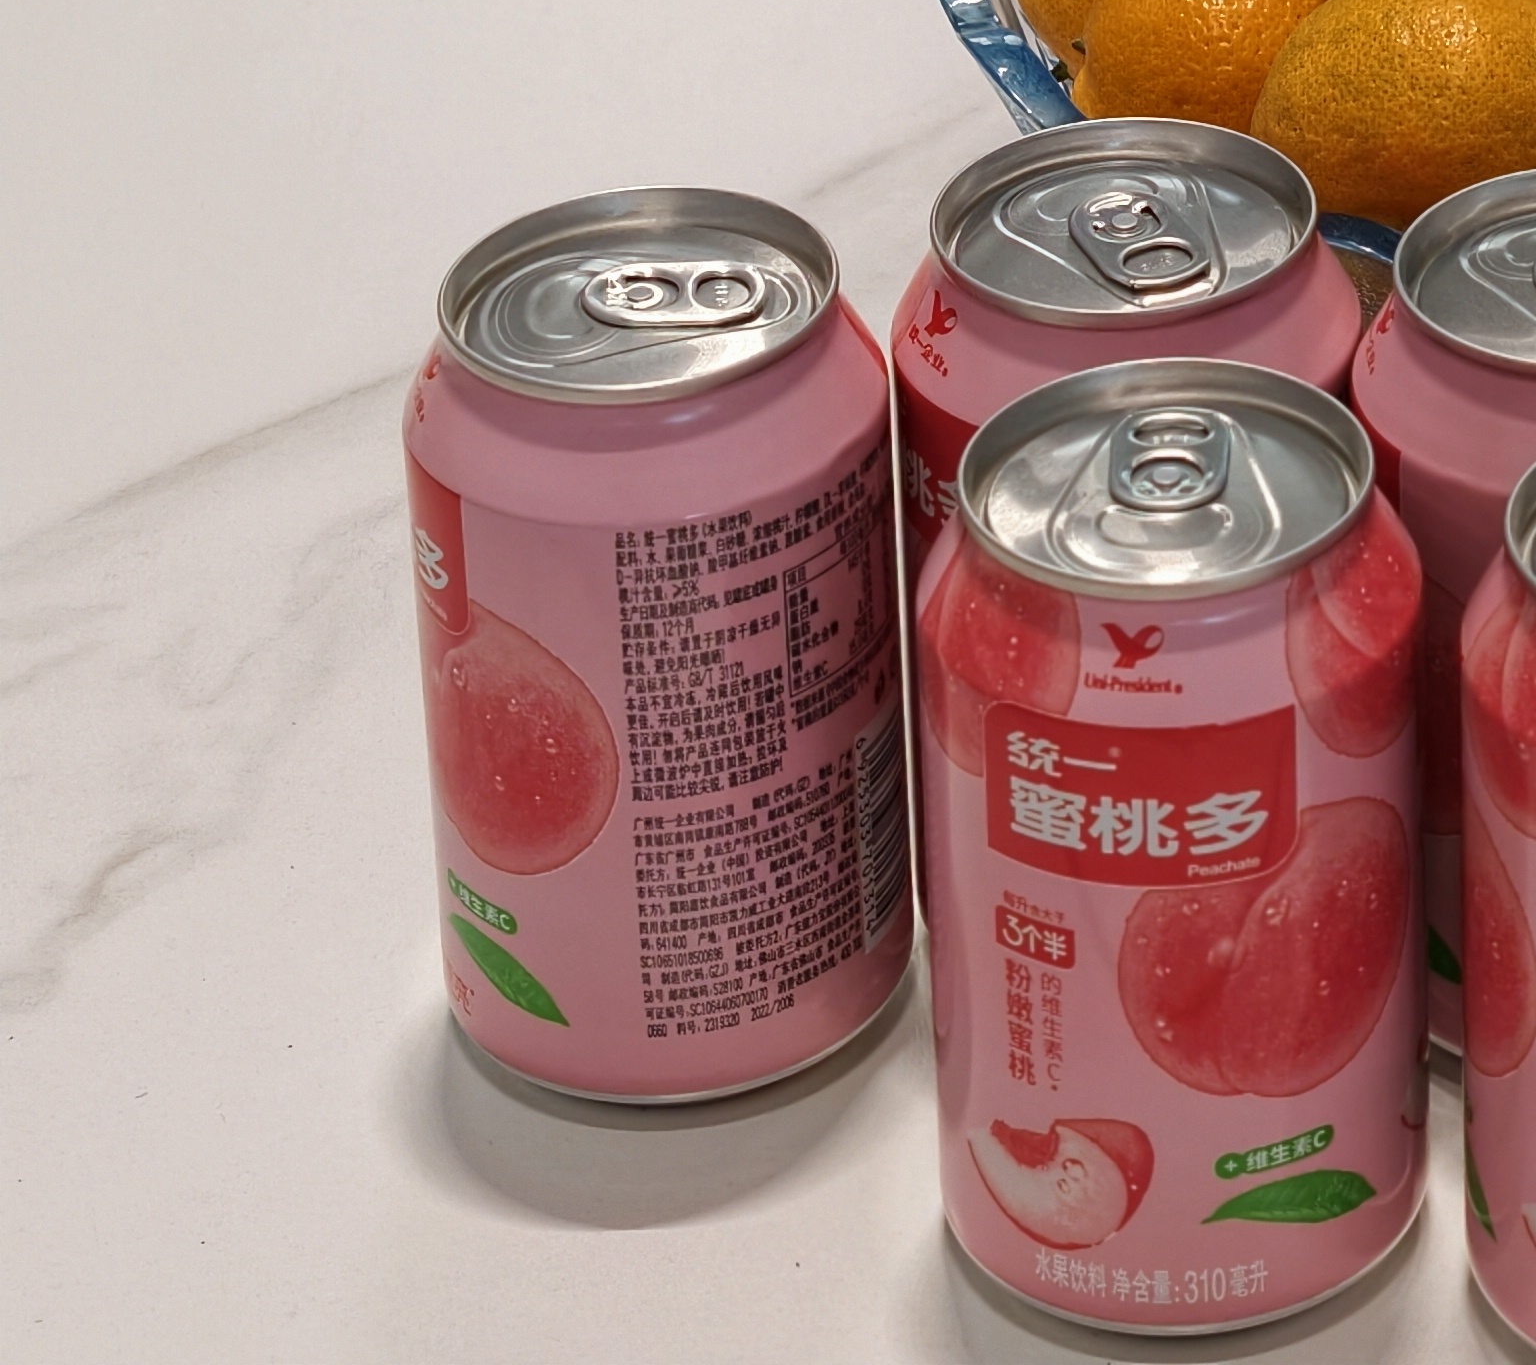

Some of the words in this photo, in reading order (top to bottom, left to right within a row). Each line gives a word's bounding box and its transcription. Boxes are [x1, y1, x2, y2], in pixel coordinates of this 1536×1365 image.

[1006, 730, 1117, 778] 统一
[1009, 775, 1269, 858] 蜜桃多
[1035, 1250, 1106, 1298] 水果饮料
